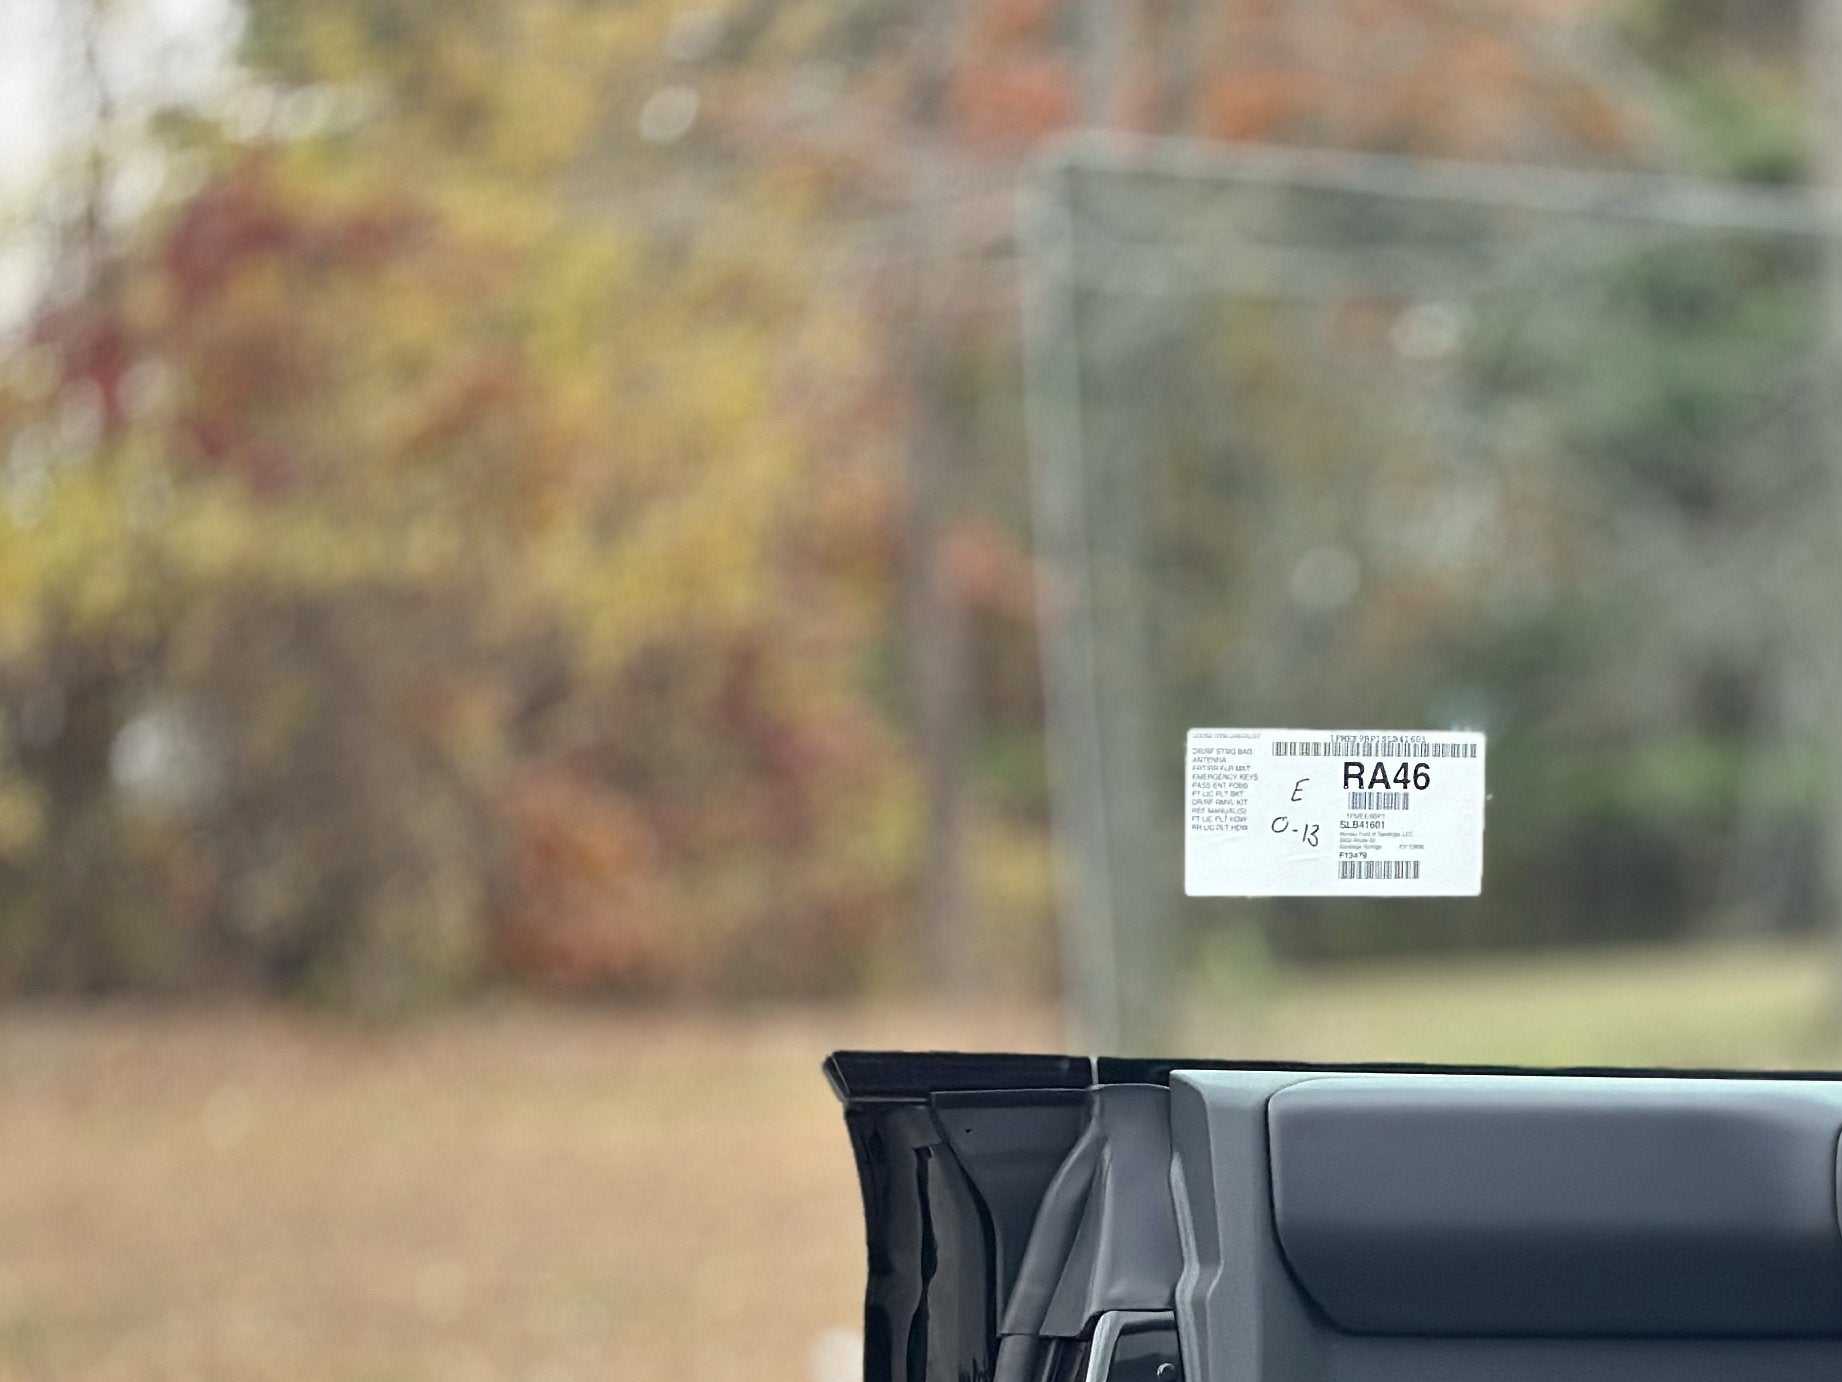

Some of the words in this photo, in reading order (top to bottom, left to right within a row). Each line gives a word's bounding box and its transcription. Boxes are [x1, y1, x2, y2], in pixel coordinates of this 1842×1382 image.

[1342, 761, 1431, 791] RA46
[1290, 778, 1310, 802] E
[1340, 821, 1385, 829] SLB41601
